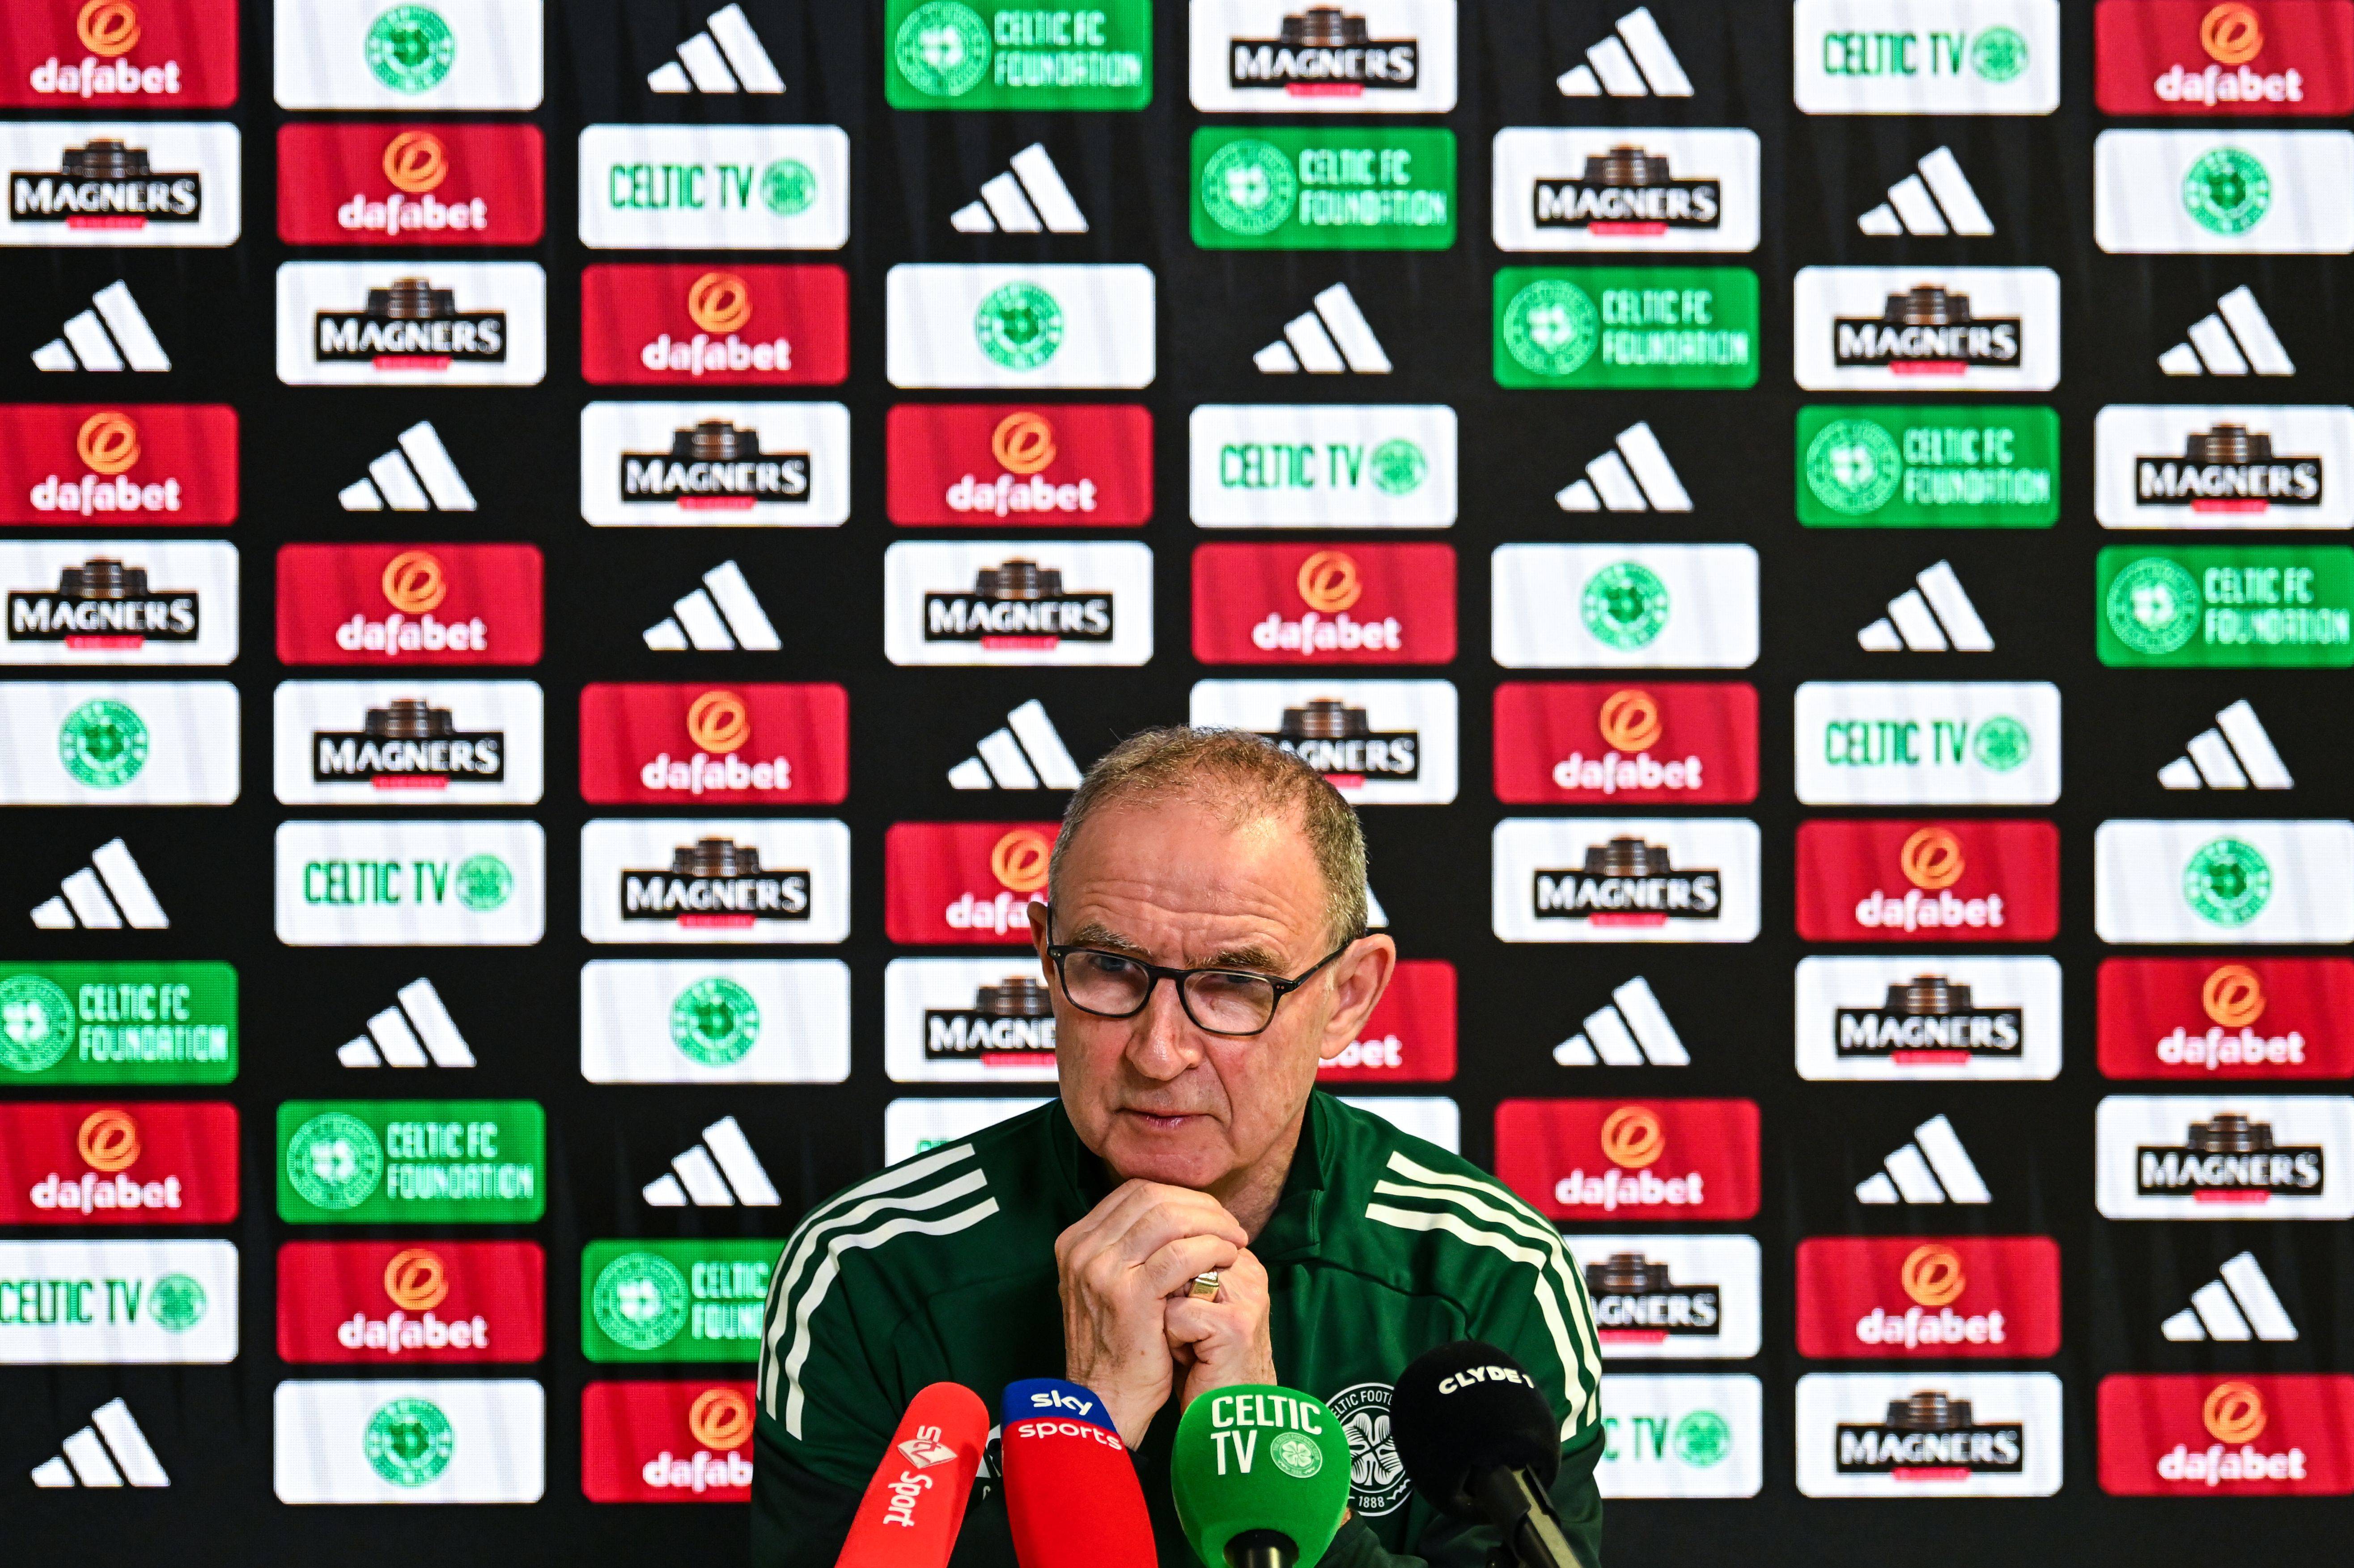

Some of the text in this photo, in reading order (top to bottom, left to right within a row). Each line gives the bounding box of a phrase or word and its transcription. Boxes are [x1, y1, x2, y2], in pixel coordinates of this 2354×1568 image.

[994, 12, 1105, 46] CELTIC FC
[995, 52, 1142, 87] FOUNDATION
[1234, 44, 1414, 82] MAGNERS
[1824, 33, 1966, 76] CELTIC TV
[30, 56, 180, 98] dafabet
[2155, 64, 2303, 106] dafabet
[1299, 149, 1410, 185] CELTIC FC
[15, 178, 195, 215] MAGNERS
[610, 164, 754, 210] CELTIC TV
[1537, 184, 1718, 221] MAGNERS
[338, 194, 486, 235] dafabet
[1299, 190, 1446, 226] FOUNDATION
[1602, 290, 1710, 324] CELTIC FC
[321, 318, 501, 353] MAGNERS
[1602, 331, 1749, 365] FOUNDATION
[1839, 325, 2019, 362] MAGNERS
[641, 334, 791, 376] dafabet
[1904, 429, 2014, 464] CELTIC FC
[625, 458, 805, 495] MAGNERS
[1219, 444, 1364, 489] CELTIC TV
[2141, 462, 2320, 499] MAGNERS
[30, 474, 180, 516] dafabet
[946, 474, 1096, 517] dafabet
[1904, 469, 2050, 504] FOUNDATION
[2204, 568, 2312, 604] CELTIC FC
[12, 595, 192, 633] MAGNERS
[929, 596, 1110, 634] MAGNERS
[2205, 608, 2350, 644] FOUNDATION
[336, 613, 486, 656] dafabet
[1252, 612, 1400, 655] dafabet
[318, 738, 499, 772] MAGNERS
[1824, 720, 1968, 766] CELTIC TV
[641, 752, 790, 794] dafabet
[1553, 752, 1702, 794] dafabet
[302, 861, 450, 906] CELTIC TV
[625, 877, 805, 913] MAGNERS
[1537, 877, 1718, 915] MAGNERS
[1856, 889, 2003, 932] dafabet
[80, 984, 190, 1021] CELTIC FC
[80, 1026, 228, 1062] FOUNDATION
[1841, 1011, 2020, 1048] MAGNERS
[2157, 1026, 2304, 1069] dafabet
[387, 1122, 498, 1158] CELTIC FC
[386, 1163, 534, 1199] FOUNDATION
[2141, 1152, 2321, 1188] MAGNERS
[30, 1173, 181, 1214] dafabet
[1555, 1169, 1703, 1211] dafabet
[691, 1261, 769, 1298] CELTIC
[0, 1279, 143, 1325] CELTIC TV
[338, 1311, 487, 1353] dafabet
[1856, 1306, 2004, 1349] dafabet
[1438, 1365, 1535, 1394] CLYDE 1
[1030, 1390, 1093, 1416] sky
[1211, 1394, 1323, 1436] CELTIC
[1018, 1422, 1123, 1450] sports
[1210, 1429, 1258, 1475] TV
[1632, 1416, 1669, 1462] TV
[1841, 1430, 2021, 1465] MAGNERS
[2158, 1444, 2306, 1486] dafabet
[882, 1471, 934, 1527] Sport
[1358, 1496, 1385, 1509] 1888
